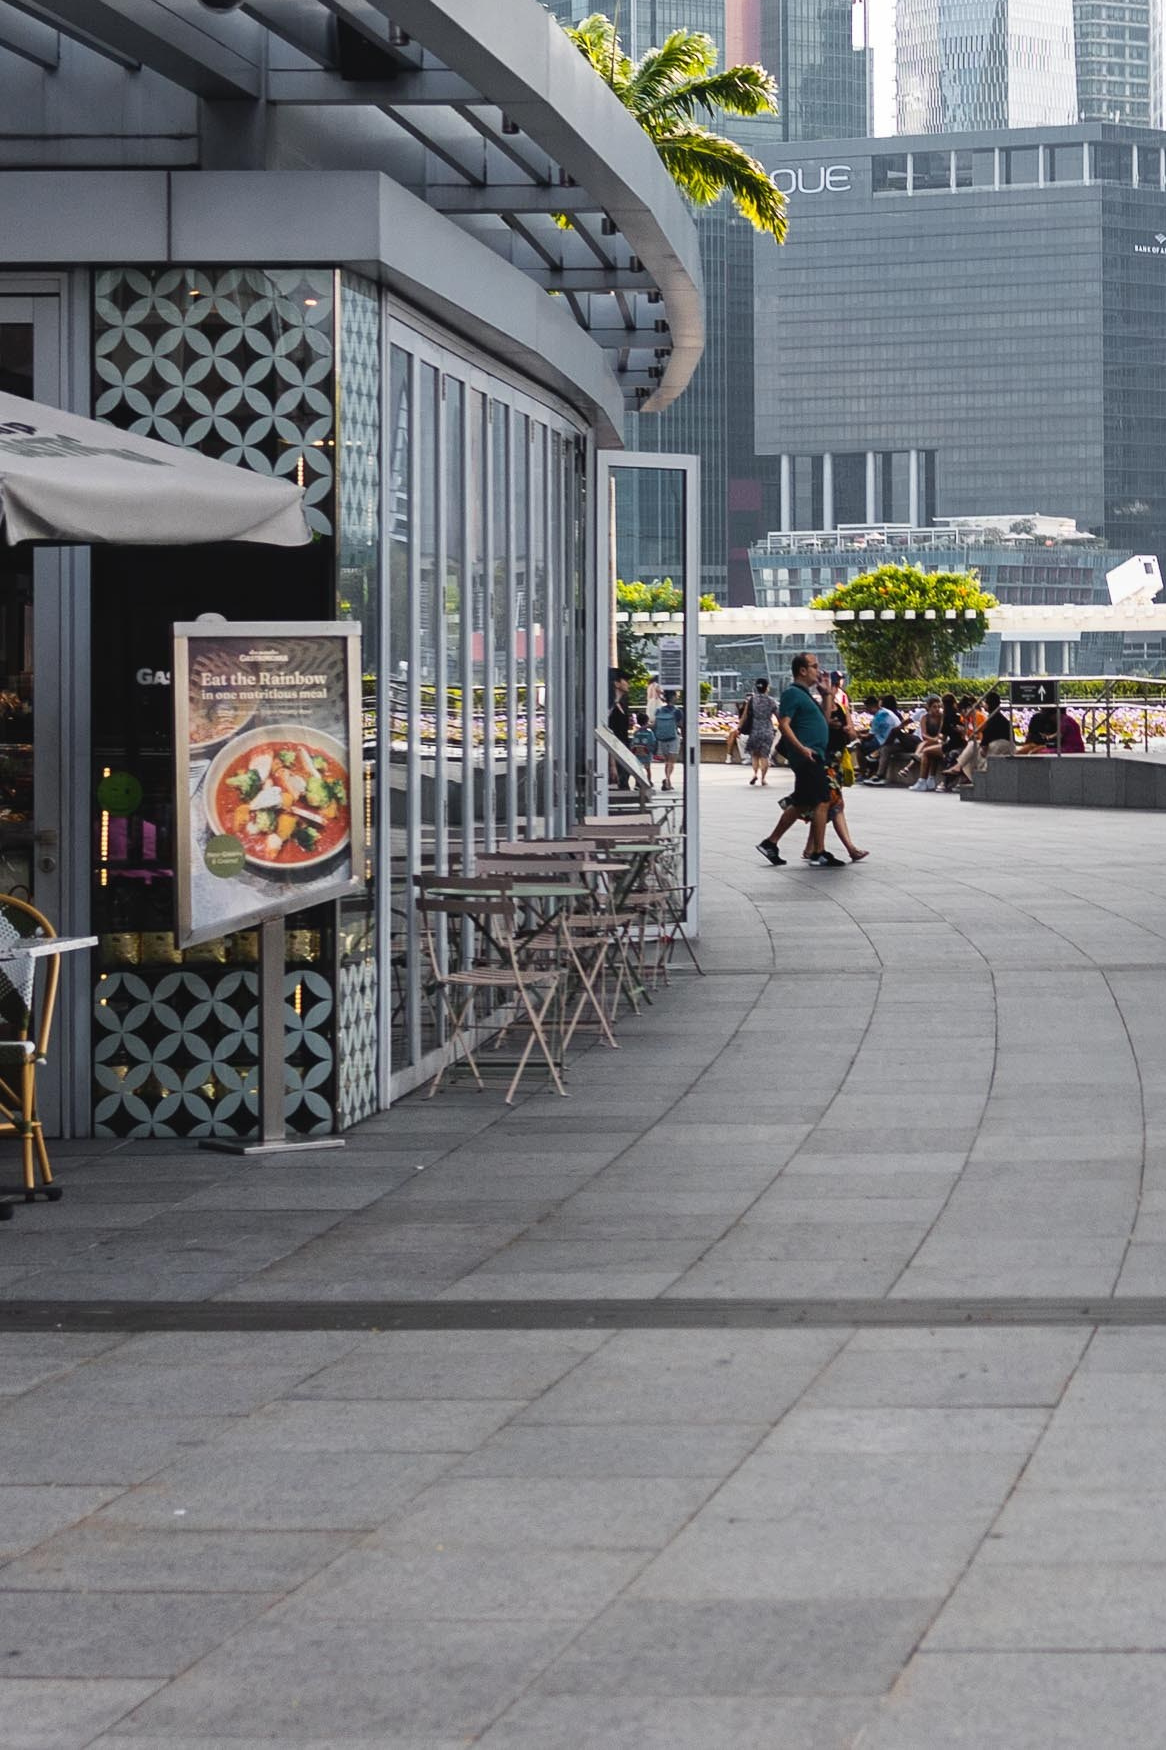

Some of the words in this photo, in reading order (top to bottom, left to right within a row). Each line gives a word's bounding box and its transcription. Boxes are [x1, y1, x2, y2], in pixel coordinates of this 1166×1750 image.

[769, 164, 852, 195] OUE
[1134, 244, 1151, 253] BANK
[1151, 246, 1160, 254] OF
[201, 672, 228, 686] Eat
[230, 671, 257, 686] the
[259, 670, 328, 685] Rainbow
[201, 690, 214, 700] in
[215, 690, 238, 700] one
[239, 689, 298, 700] nutritious
[299, 688, 328, 699] meal
